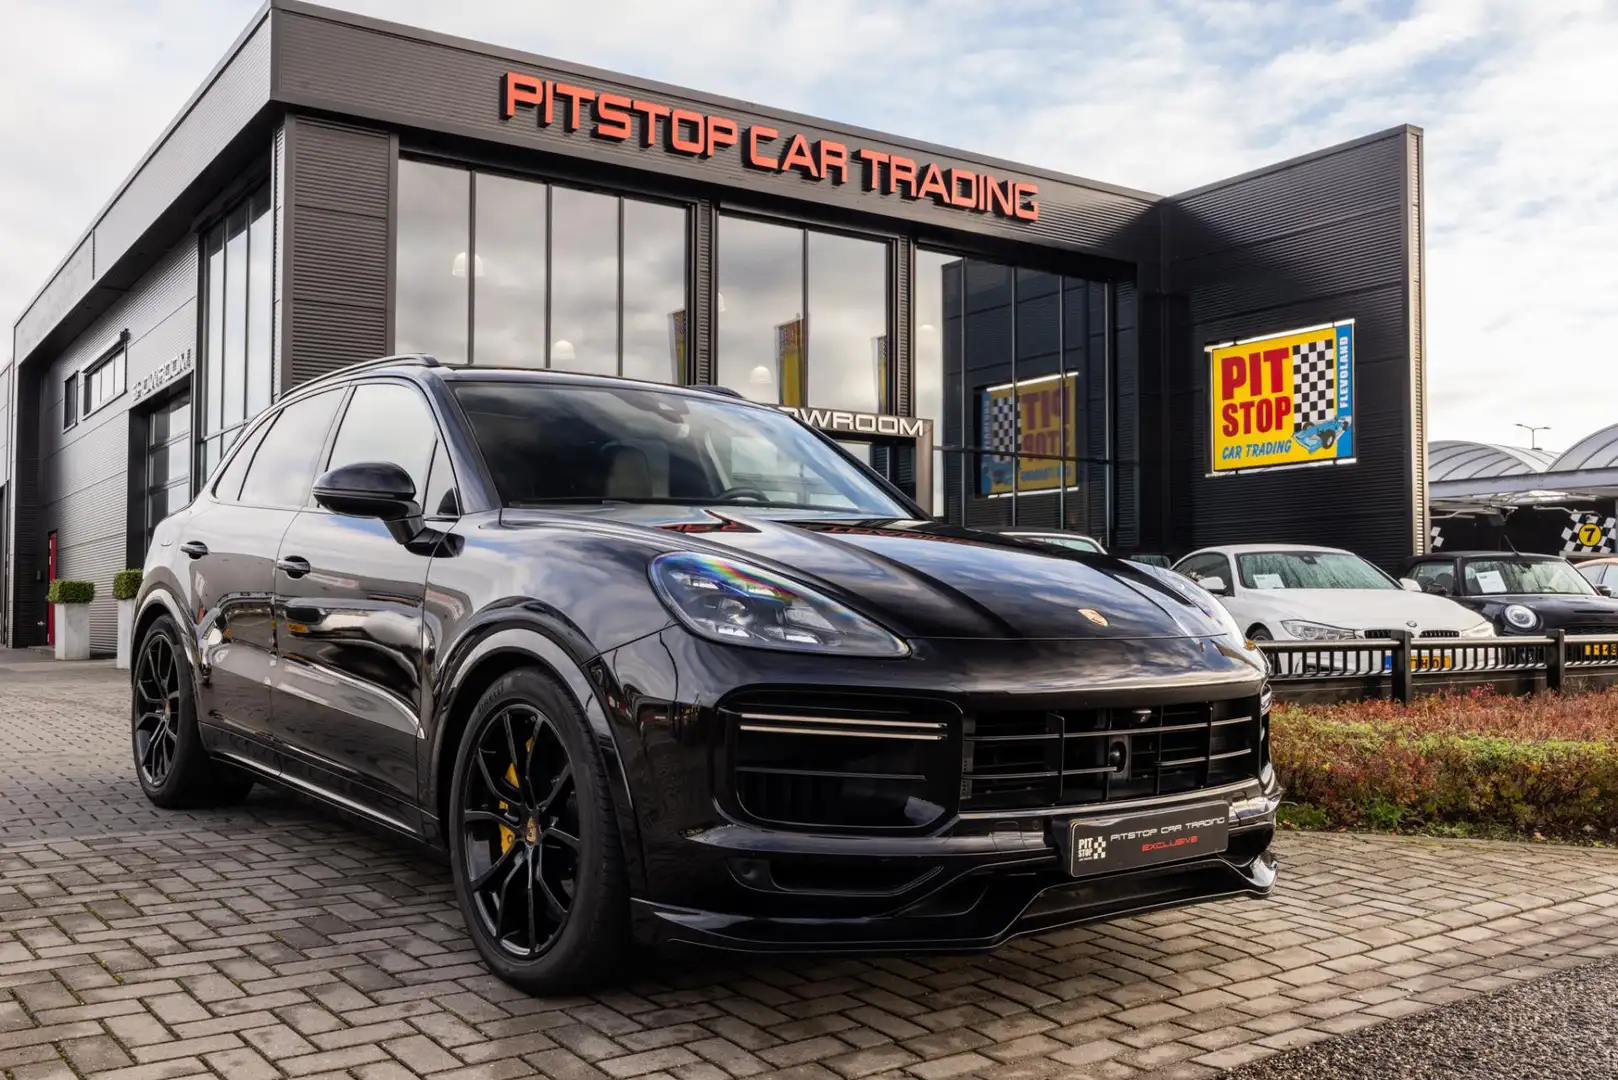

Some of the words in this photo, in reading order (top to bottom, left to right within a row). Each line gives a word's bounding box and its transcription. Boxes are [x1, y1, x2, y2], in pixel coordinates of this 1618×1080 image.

[505, 71, 739, 158] PITSTOP
[749, 125, 850, 183] CAR
[858, 148, 1041, 221] TRADING
[1221, 347, 1290, 401] PIT
[1339, 336, 1349, 409] FLEVOLAND
[1222, 395, 1292, 438] STOP
[1222, 446, 1242, 461] CAR
[1246, 440, 1292, 458] TRADING
[1584, 527, 1597, 543] 7
[1110, 828, 1158, 842] PITSTOP
[1160, 824, 1183, 835] CAR
[1185, 816, 1226, 830] TRADING
[1078, 837, 1094, 850] PIT
[1141, 835, 1199, 852] EXCLUSIVE
